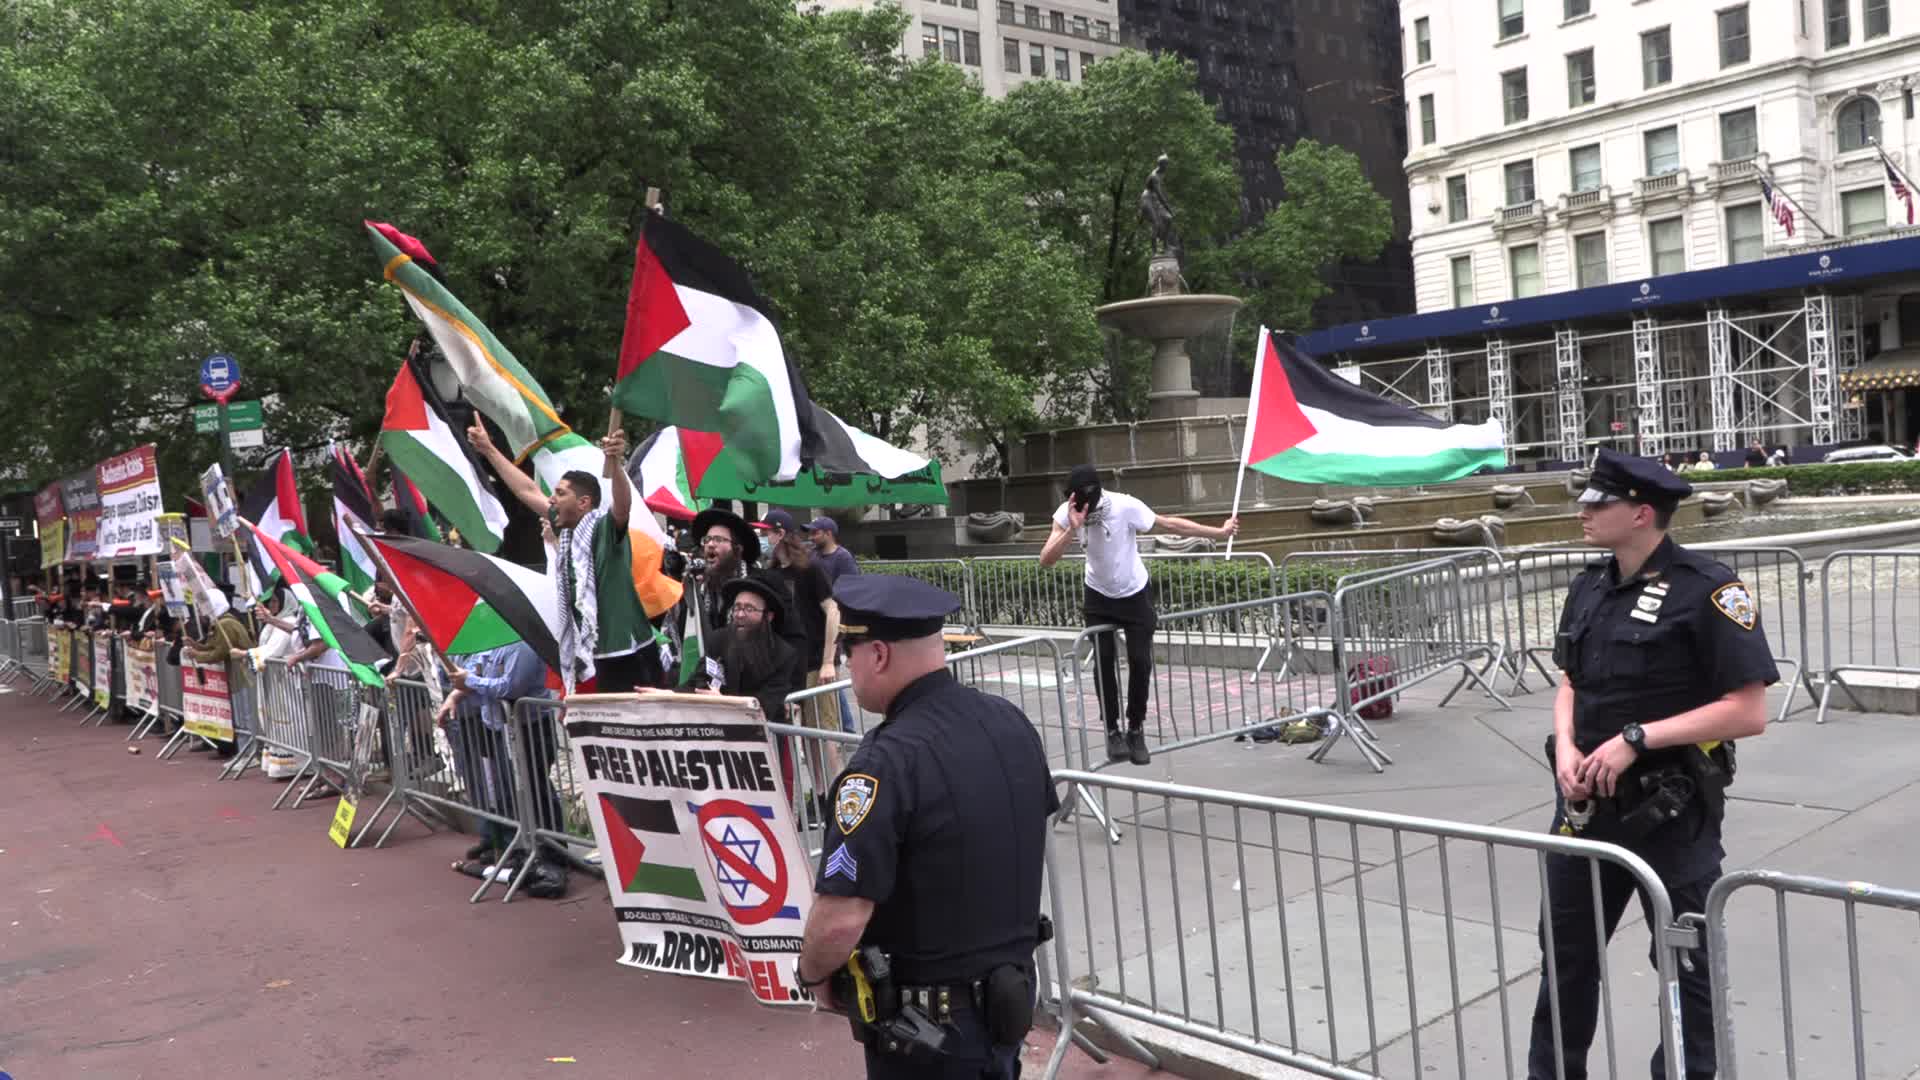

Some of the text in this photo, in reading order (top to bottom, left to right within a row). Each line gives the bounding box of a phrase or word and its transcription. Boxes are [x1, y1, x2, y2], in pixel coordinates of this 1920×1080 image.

[656, 728, 674, 737] NAME
[674, 728, 685, 737] OF
[687, 728, 700, 737] THE
[700, 728, 725, 737] TORAH
[581, 744, 776, 791] FREE PALESTINE
[624, 911, 660, 920] SO-CALLED
